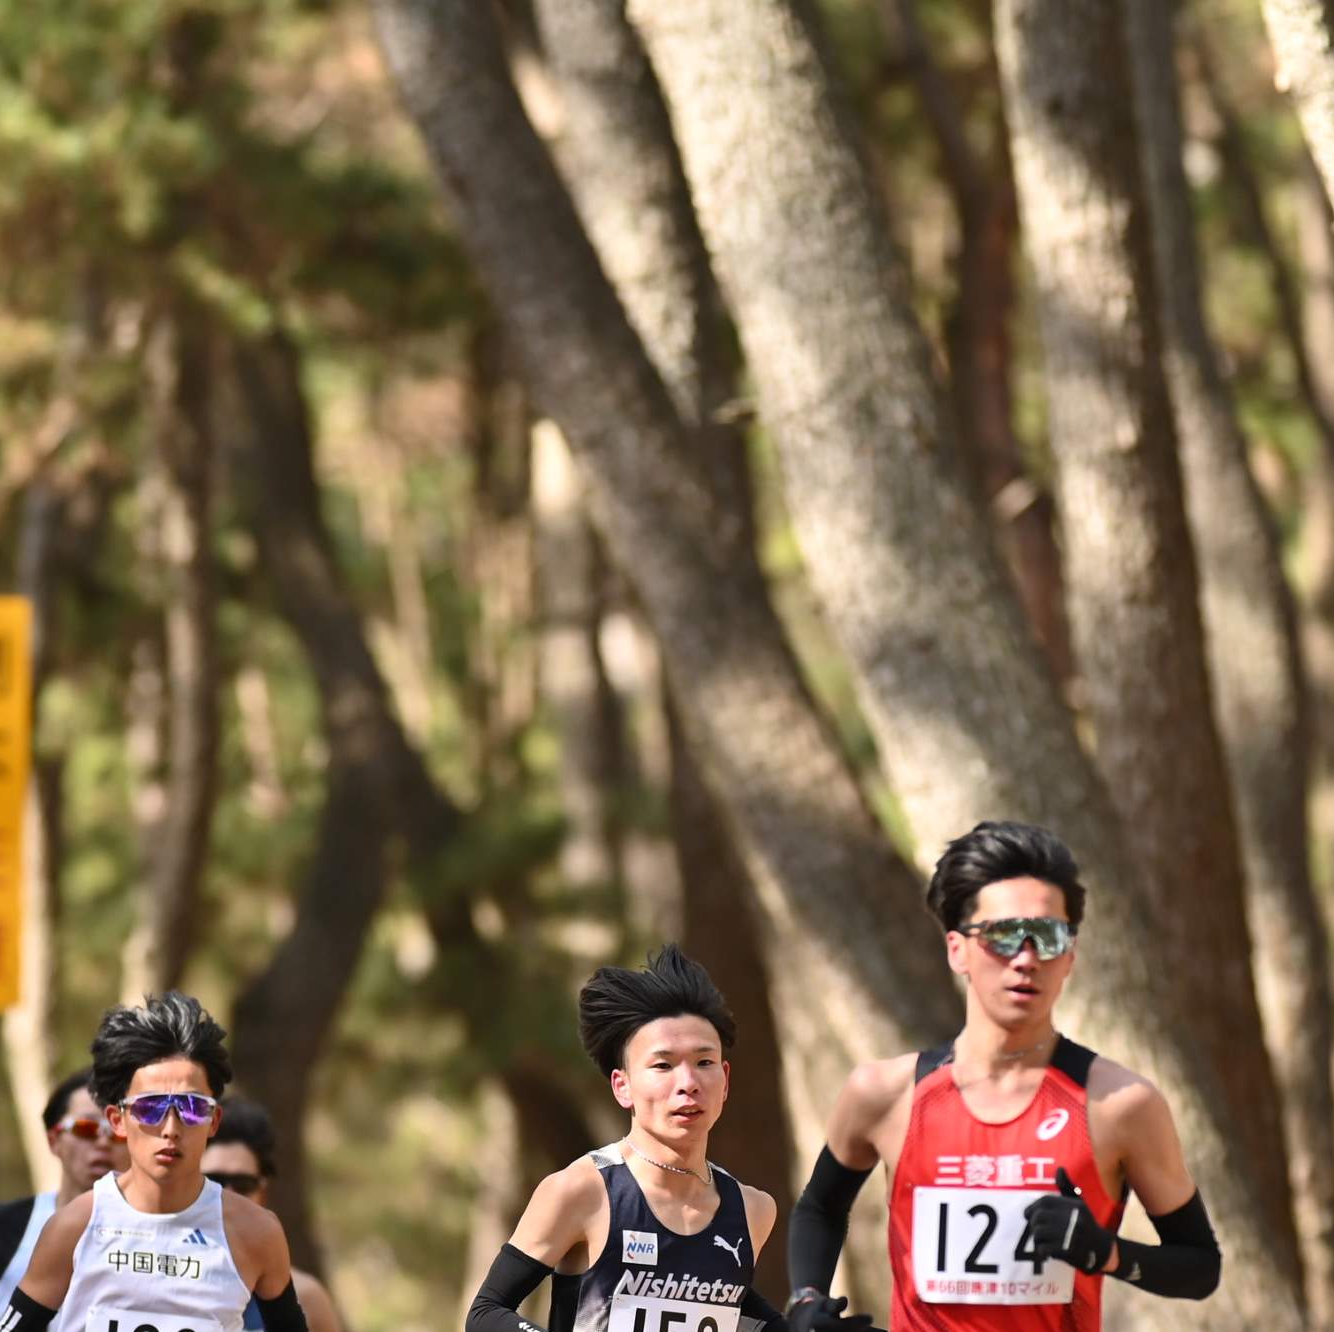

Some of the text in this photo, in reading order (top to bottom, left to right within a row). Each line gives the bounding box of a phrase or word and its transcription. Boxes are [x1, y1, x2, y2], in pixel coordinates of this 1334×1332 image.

[934, 1155, 1055, 1187] 三菱重工
[627, 1242, 655, 1254] NNR
[936, 1202, 1047, 1276] 124
[108, 1249, 200, 1279] 中国電力
[613, 1268, 745, 1303] Nishitetsu
